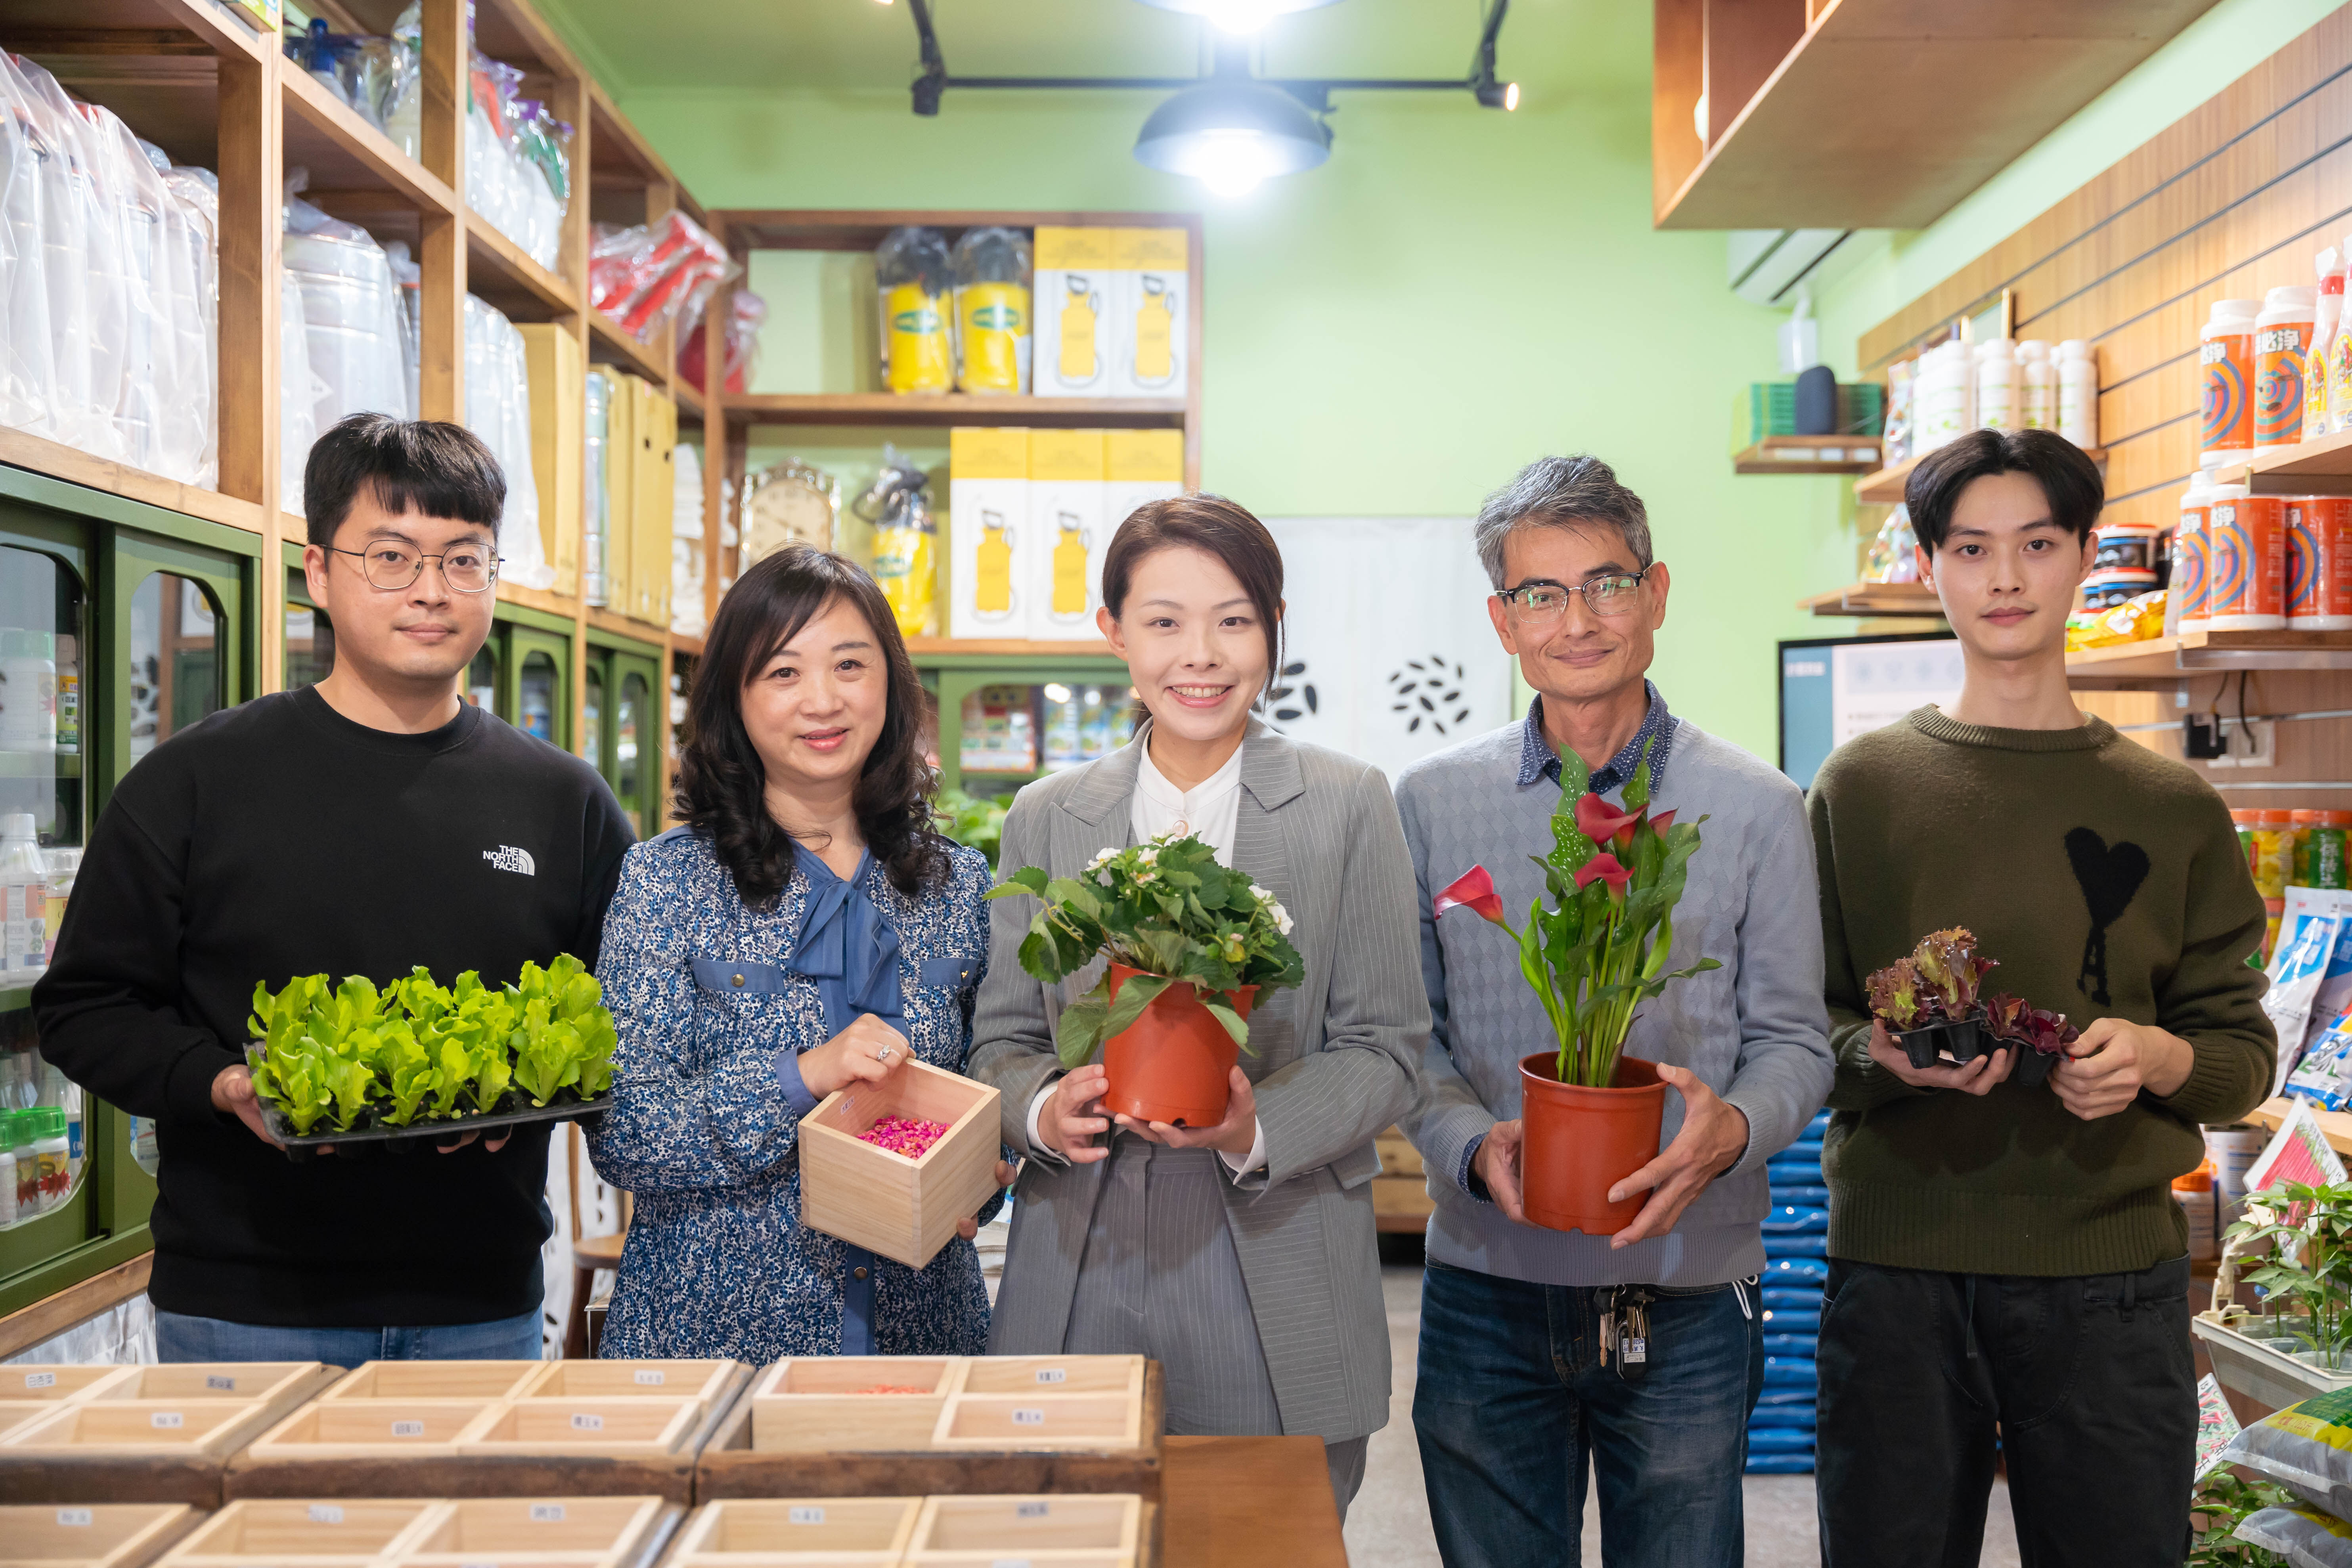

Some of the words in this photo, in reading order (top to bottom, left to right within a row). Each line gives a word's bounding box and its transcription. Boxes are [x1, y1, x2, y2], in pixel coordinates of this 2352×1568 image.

[499, 844, 519, 856] THE
[483, 850, 519, 863] NORTH
[493, 860, 519, 872] FACE
